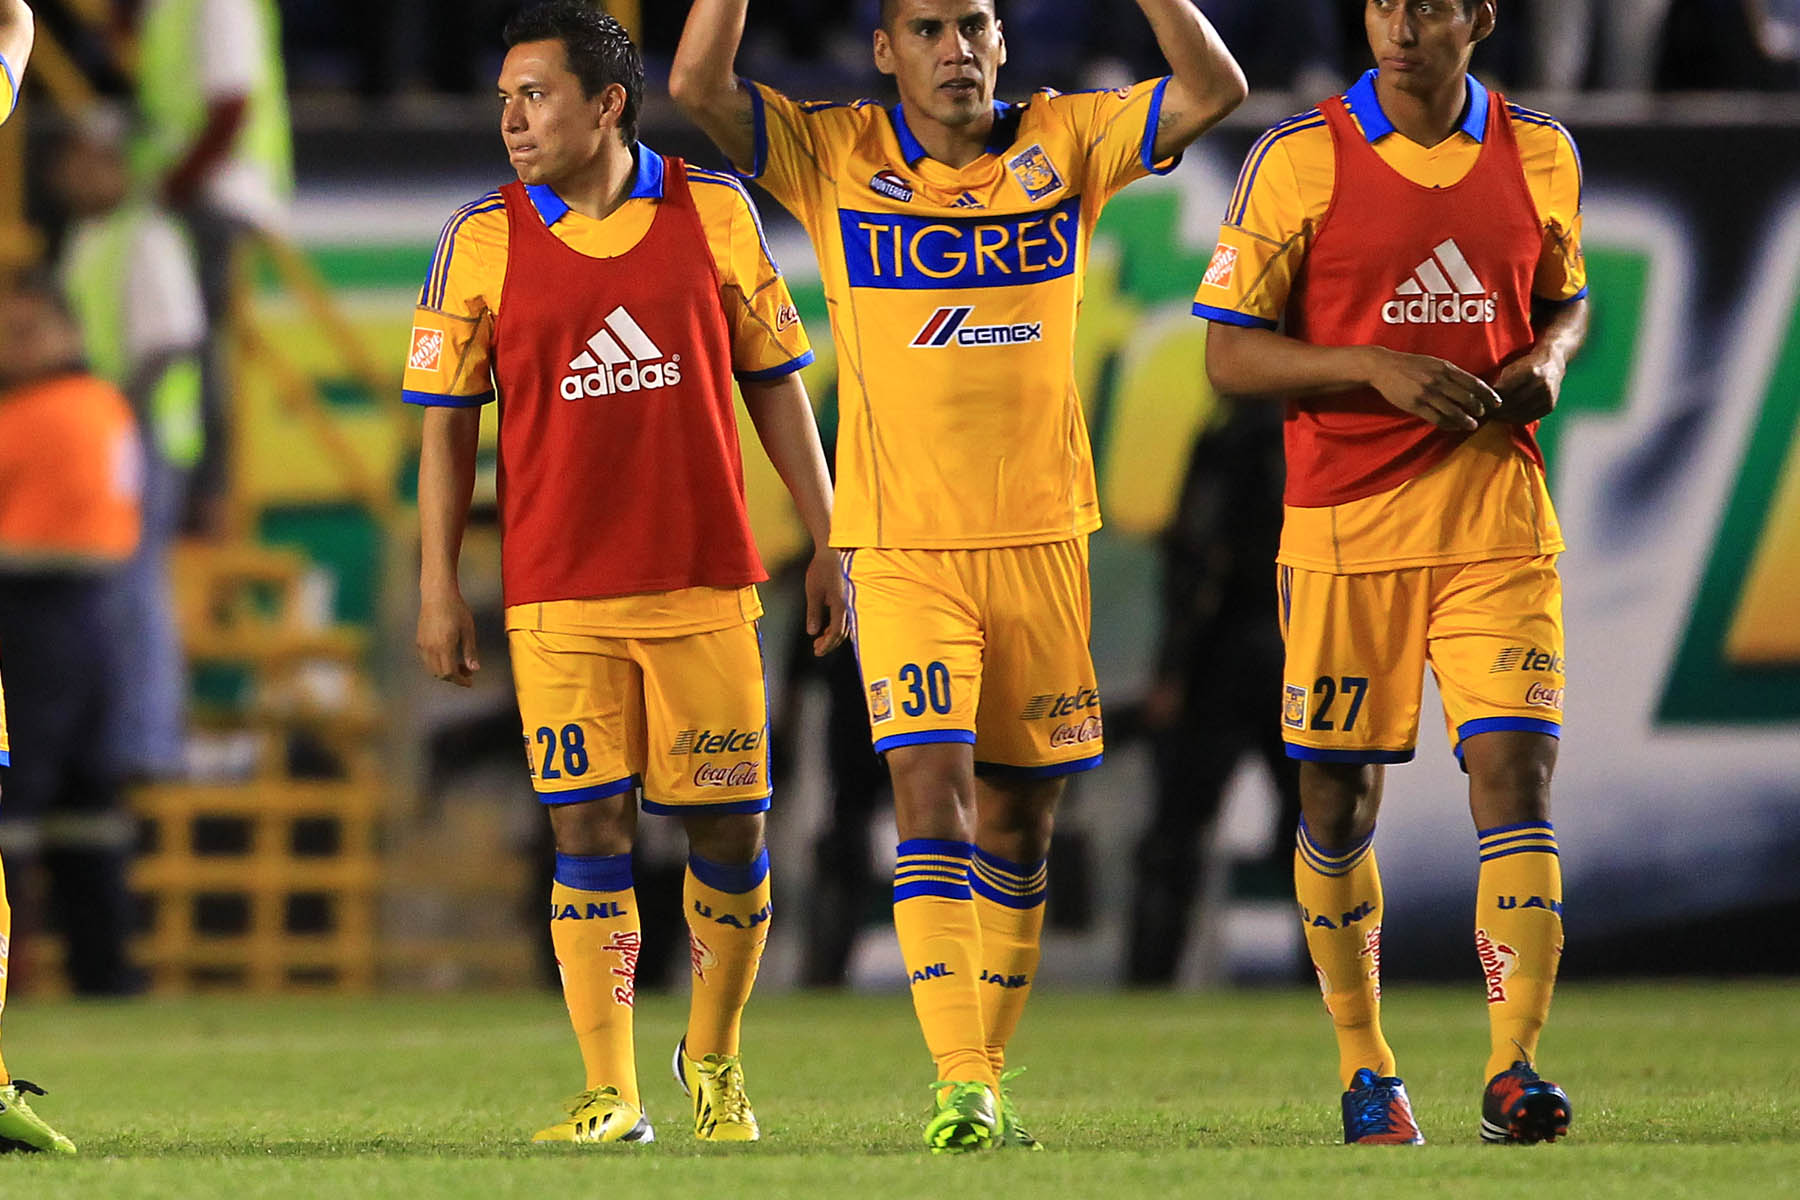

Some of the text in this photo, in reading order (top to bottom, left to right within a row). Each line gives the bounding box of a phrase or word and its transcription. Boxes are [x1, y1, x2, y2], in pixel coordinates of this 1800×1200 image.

[871, 176, 913, 202] MONTERREY
[858, 211, 1070, 279] TIGRES
[1380, 292, 1497, 326] adidas
[957, 321, 1042, 347] CEMEX
[560, 359, 681, 402] adidas
[898, 660, 952, 718] 30
[1049, 686, 1103, 718] telce
[1310, 675, 1369, 732] 27
[536, 723, 590, 780] 28
[693, 725, 768, 754] telcel
[694, 761, 760, 787] Coca-Cola
[912, 962, 955, 985] ANL
